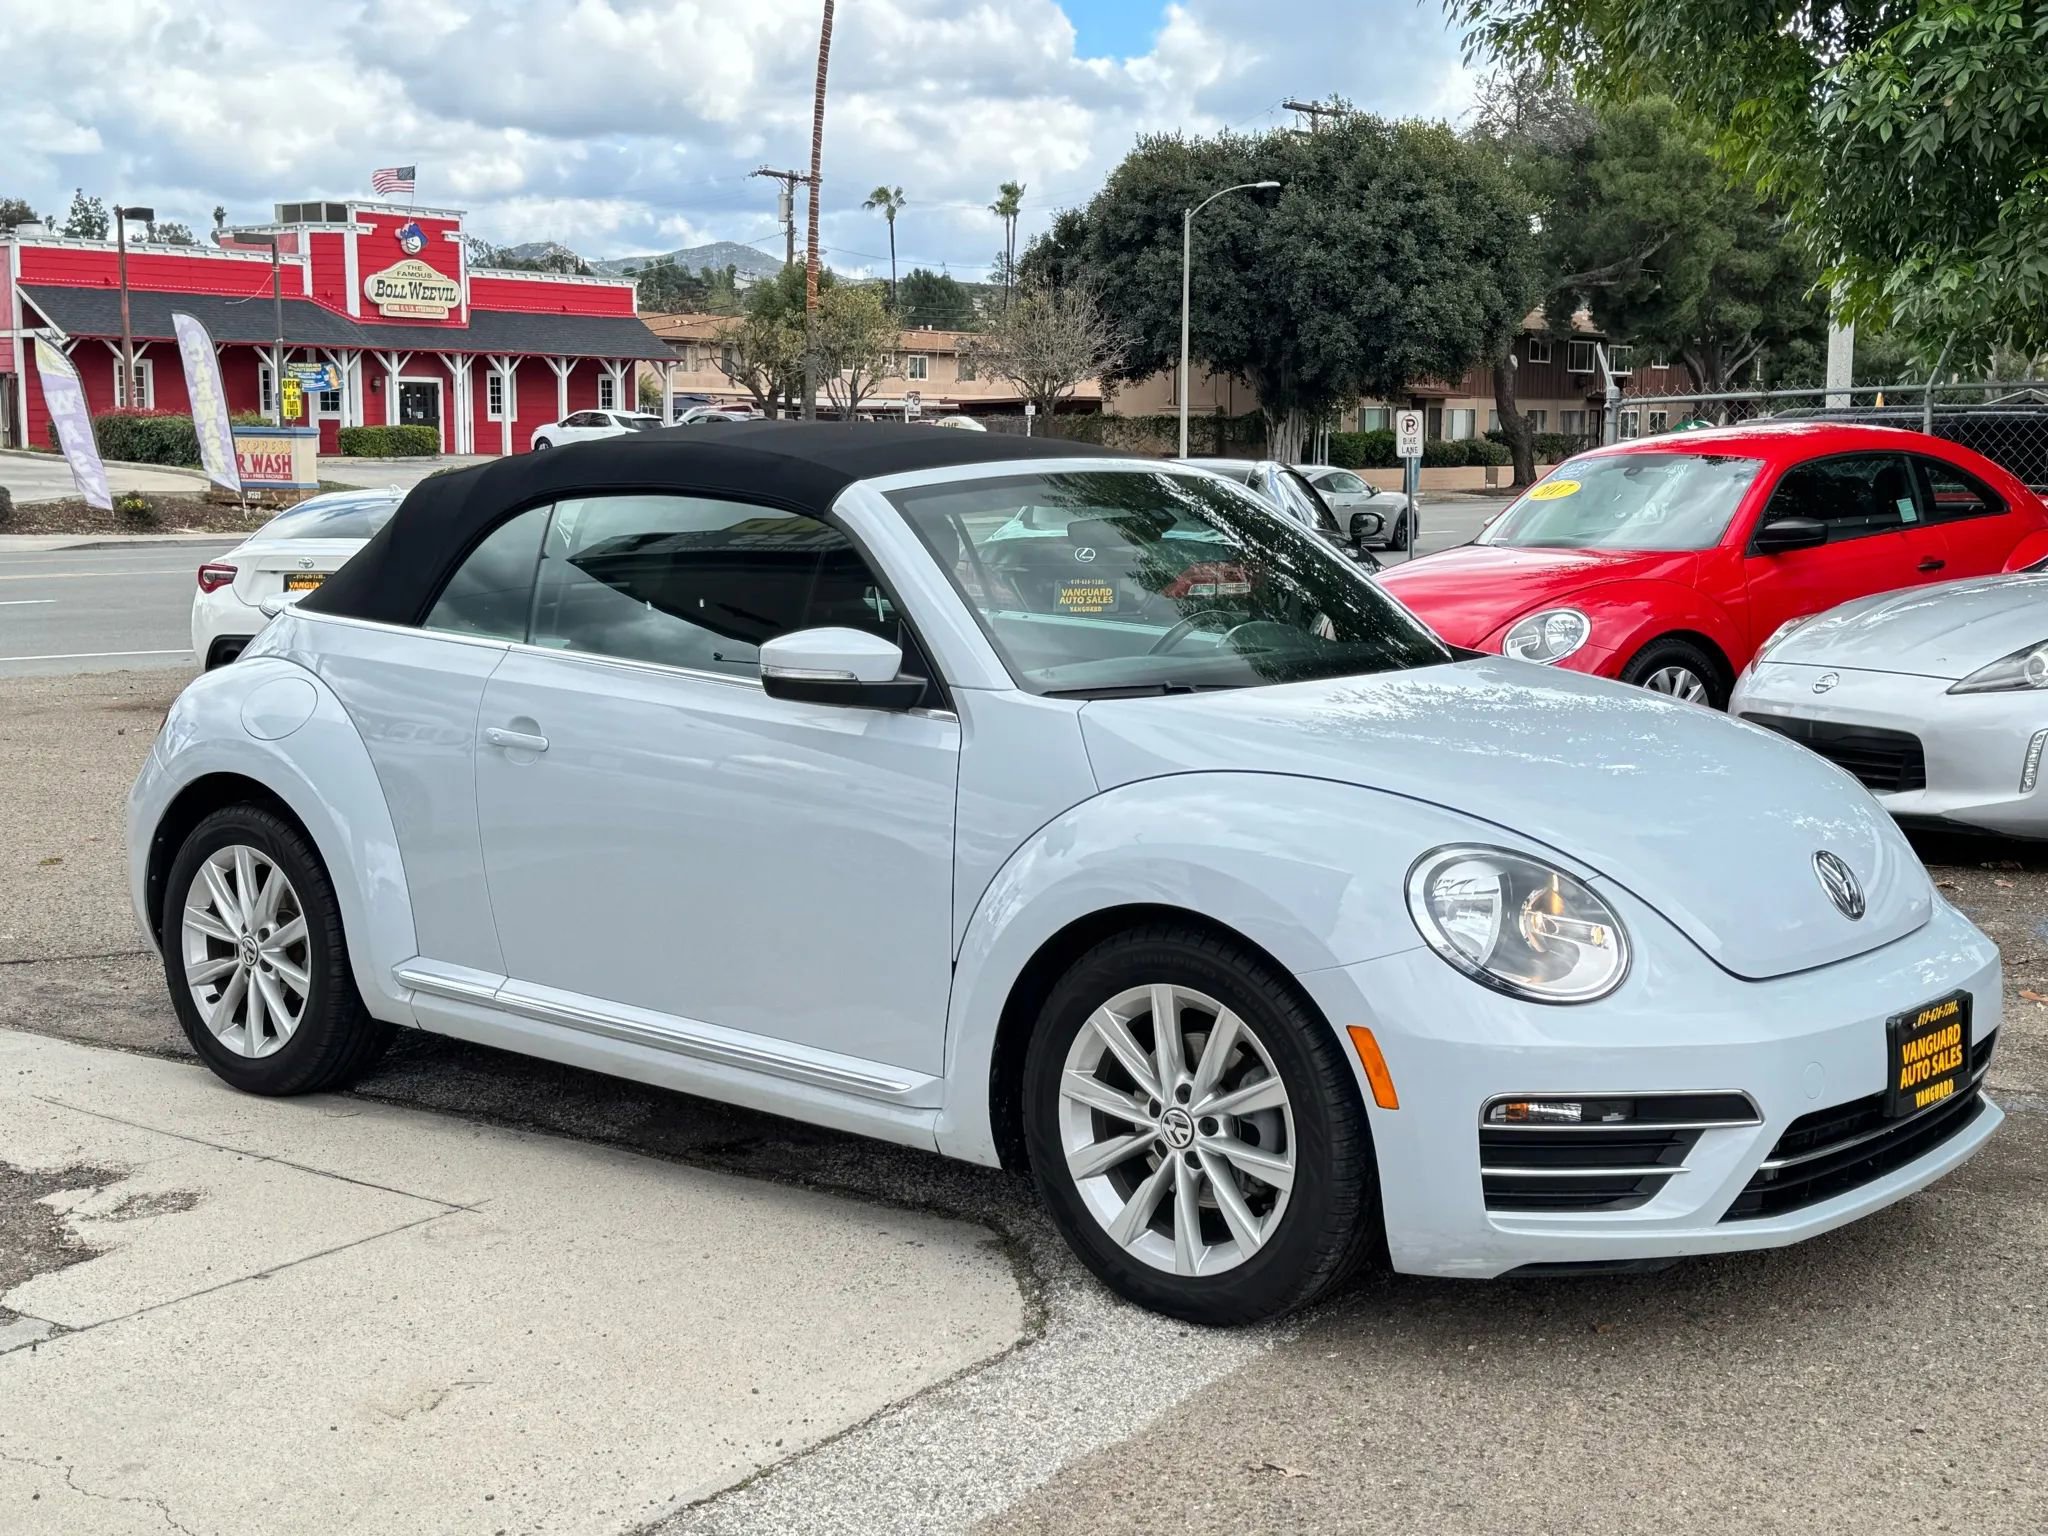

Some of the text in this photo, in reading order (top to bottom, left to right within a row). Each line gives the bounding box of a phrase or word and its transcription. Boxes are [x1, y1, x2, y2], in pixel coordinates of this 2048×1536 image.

[396, 271, 433, 279] FAMOUS
[374, 279, 456, 302] BOLL WEEVIL
[282, 380, 301, 389] OPEN
[1402, 437, 1417, 445] BIKE
[1401, 446, 1418, 454] LANE
[250, 453, 292, 473] WASH
[288, 581, 321, 589] VANGUA
[1061, 587, 1113, 597] VANGUARD
[1059, 596, 1114, 604] AUTO SALES
[1902, 1023, 1961, 1065] VANGUARD
[1900, 1044, 1963, 1090] AUTO SALES
[1915, 1078, 1954, 1108] VANGUARD
